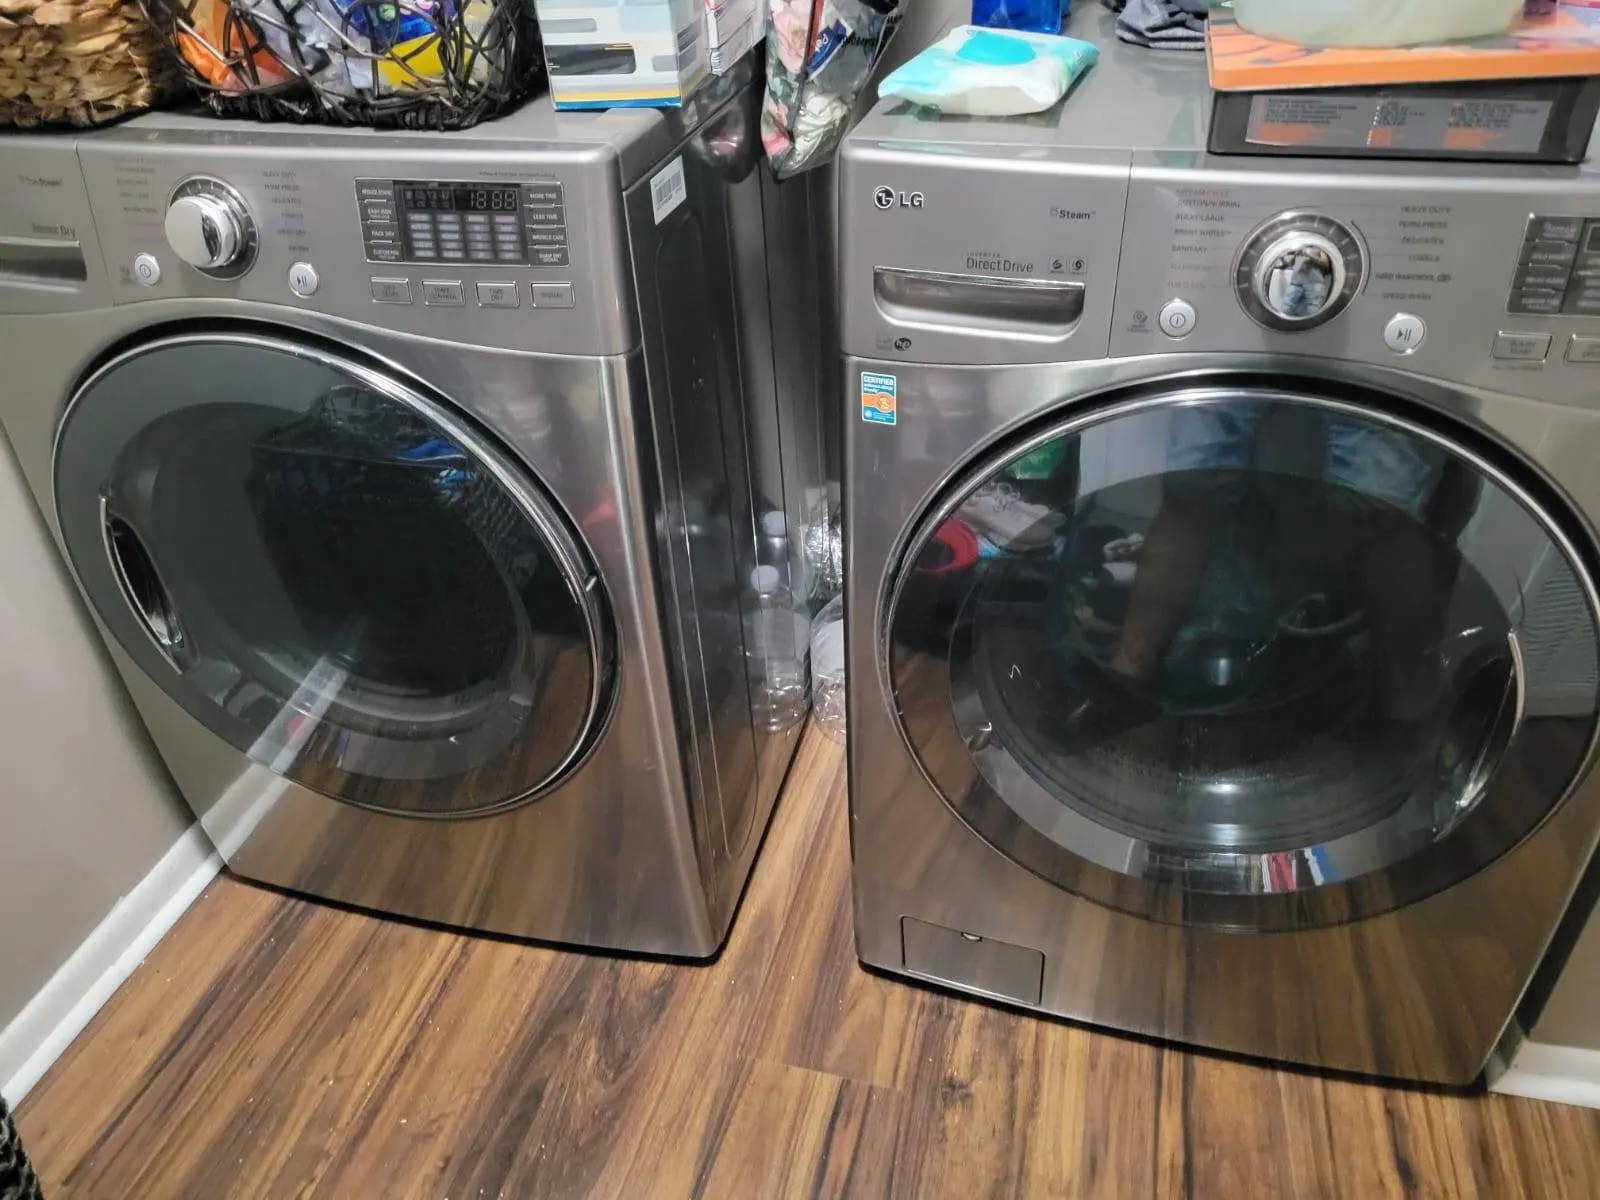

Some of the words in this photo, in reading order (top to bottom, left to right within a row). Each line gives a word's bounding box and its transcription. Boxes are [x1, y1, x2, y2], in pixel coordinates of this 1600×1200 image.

[899, 192, 924, 209] LG
[966, 257, 1001, 272] Direct
[1003, 259, 1034, 273] Drive
